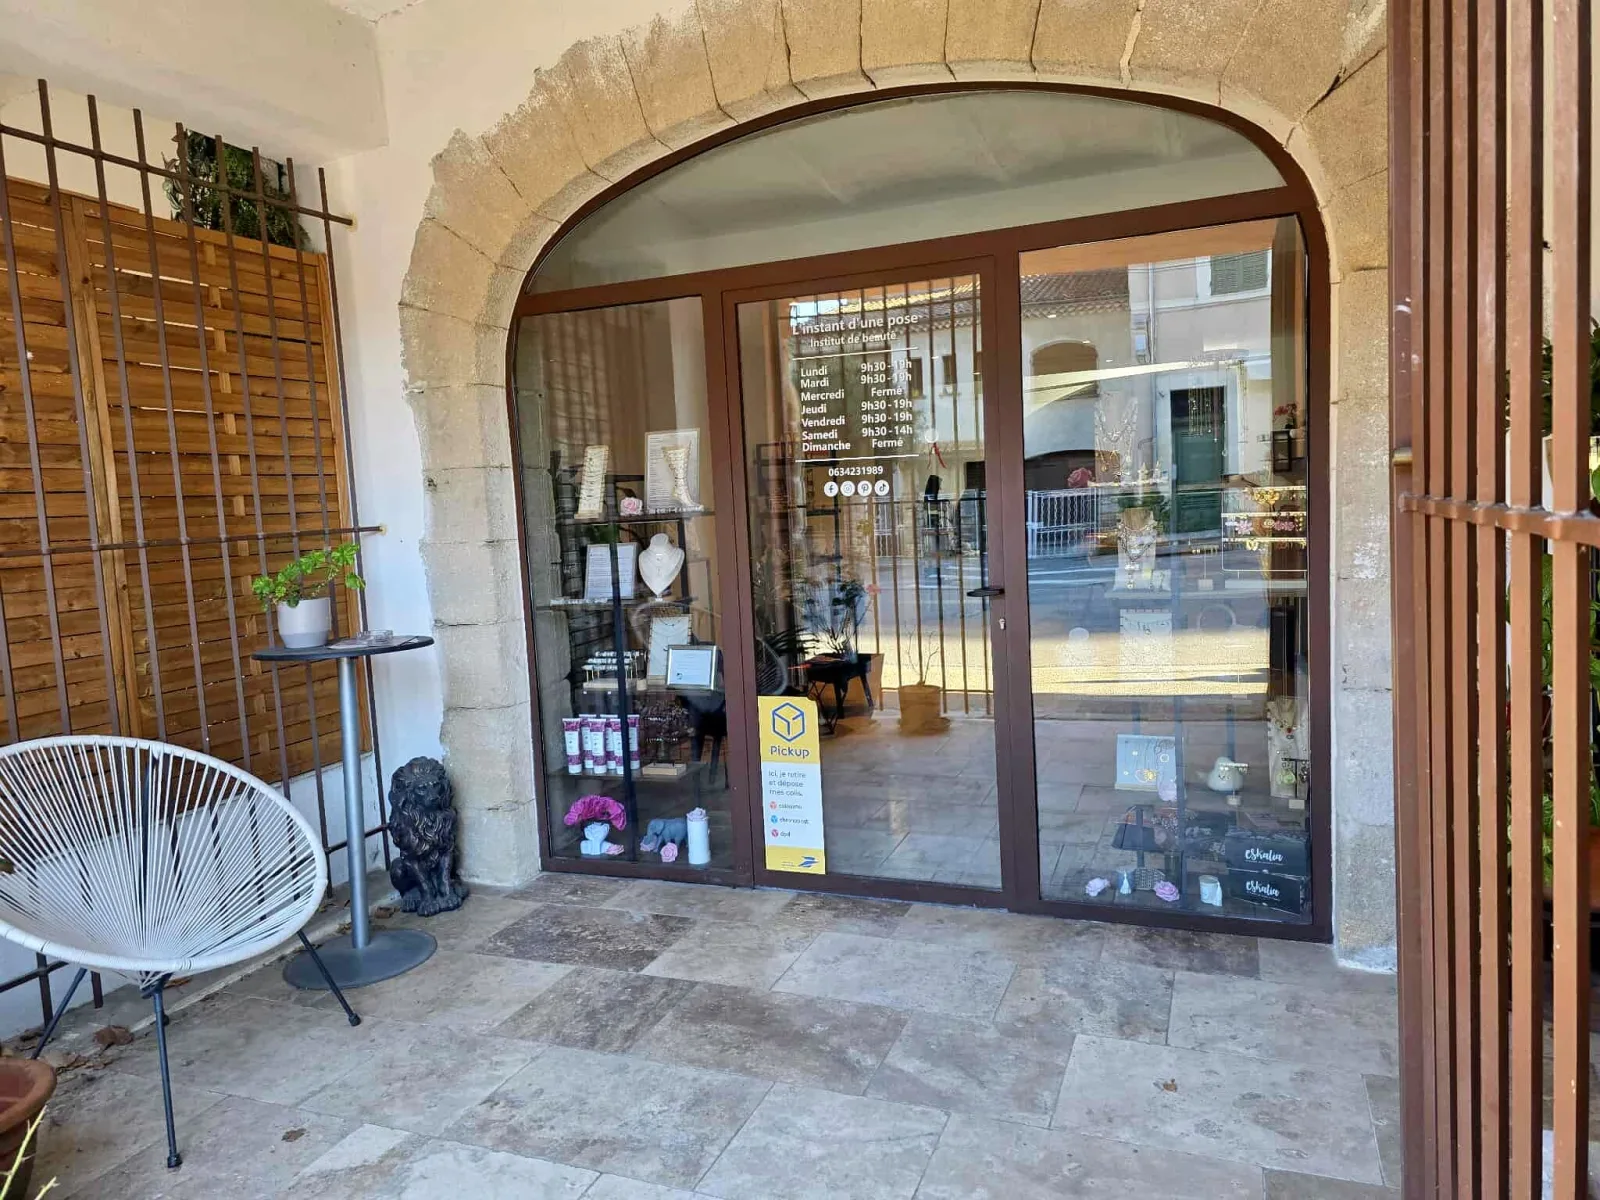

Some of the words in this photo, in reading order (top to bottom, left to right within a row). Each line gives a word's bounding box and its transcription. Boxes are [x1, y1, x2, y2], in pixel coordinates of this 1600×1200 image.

[792, 320, 845, 335] L'instant
[848, 317, 884, 329] d'une
[887, 313, 918, 328] pose
[810, 335, 844, 347] Institut
[847, 333, 860, 344] de
[862, 331, 897, 342] beauté
[800, 366, 828, 377] Lundi
[860, 361, 886, 373] 9h30
[800, 377, 829, 388] Mardi
[860, 373, 886, 385] 9h30
[800, 389, 845, 401] Mercredi
[871, 386, 903, 397] Fermé
[801, 404, 827, 415] Jeudi
[861, 400, 886, 411] 9h30
[893, 398, 913, 409] 19h
[801, 415, 845, 428] Vendredi
[861, 412, 886, 424] 9h30
[894, 411, 913, 422] 19h
[802, 429, 838, 440] Samedi
[861, 426, 887, 437] 9h30
[894, 424, 913, 435] 14h
[802, 440, 851, 452] Dimanche
[871, 438, 904, 448] Fermé
[828, 465, 884, 477] 0634231989
[770, 745, 810, 759] Pickup
